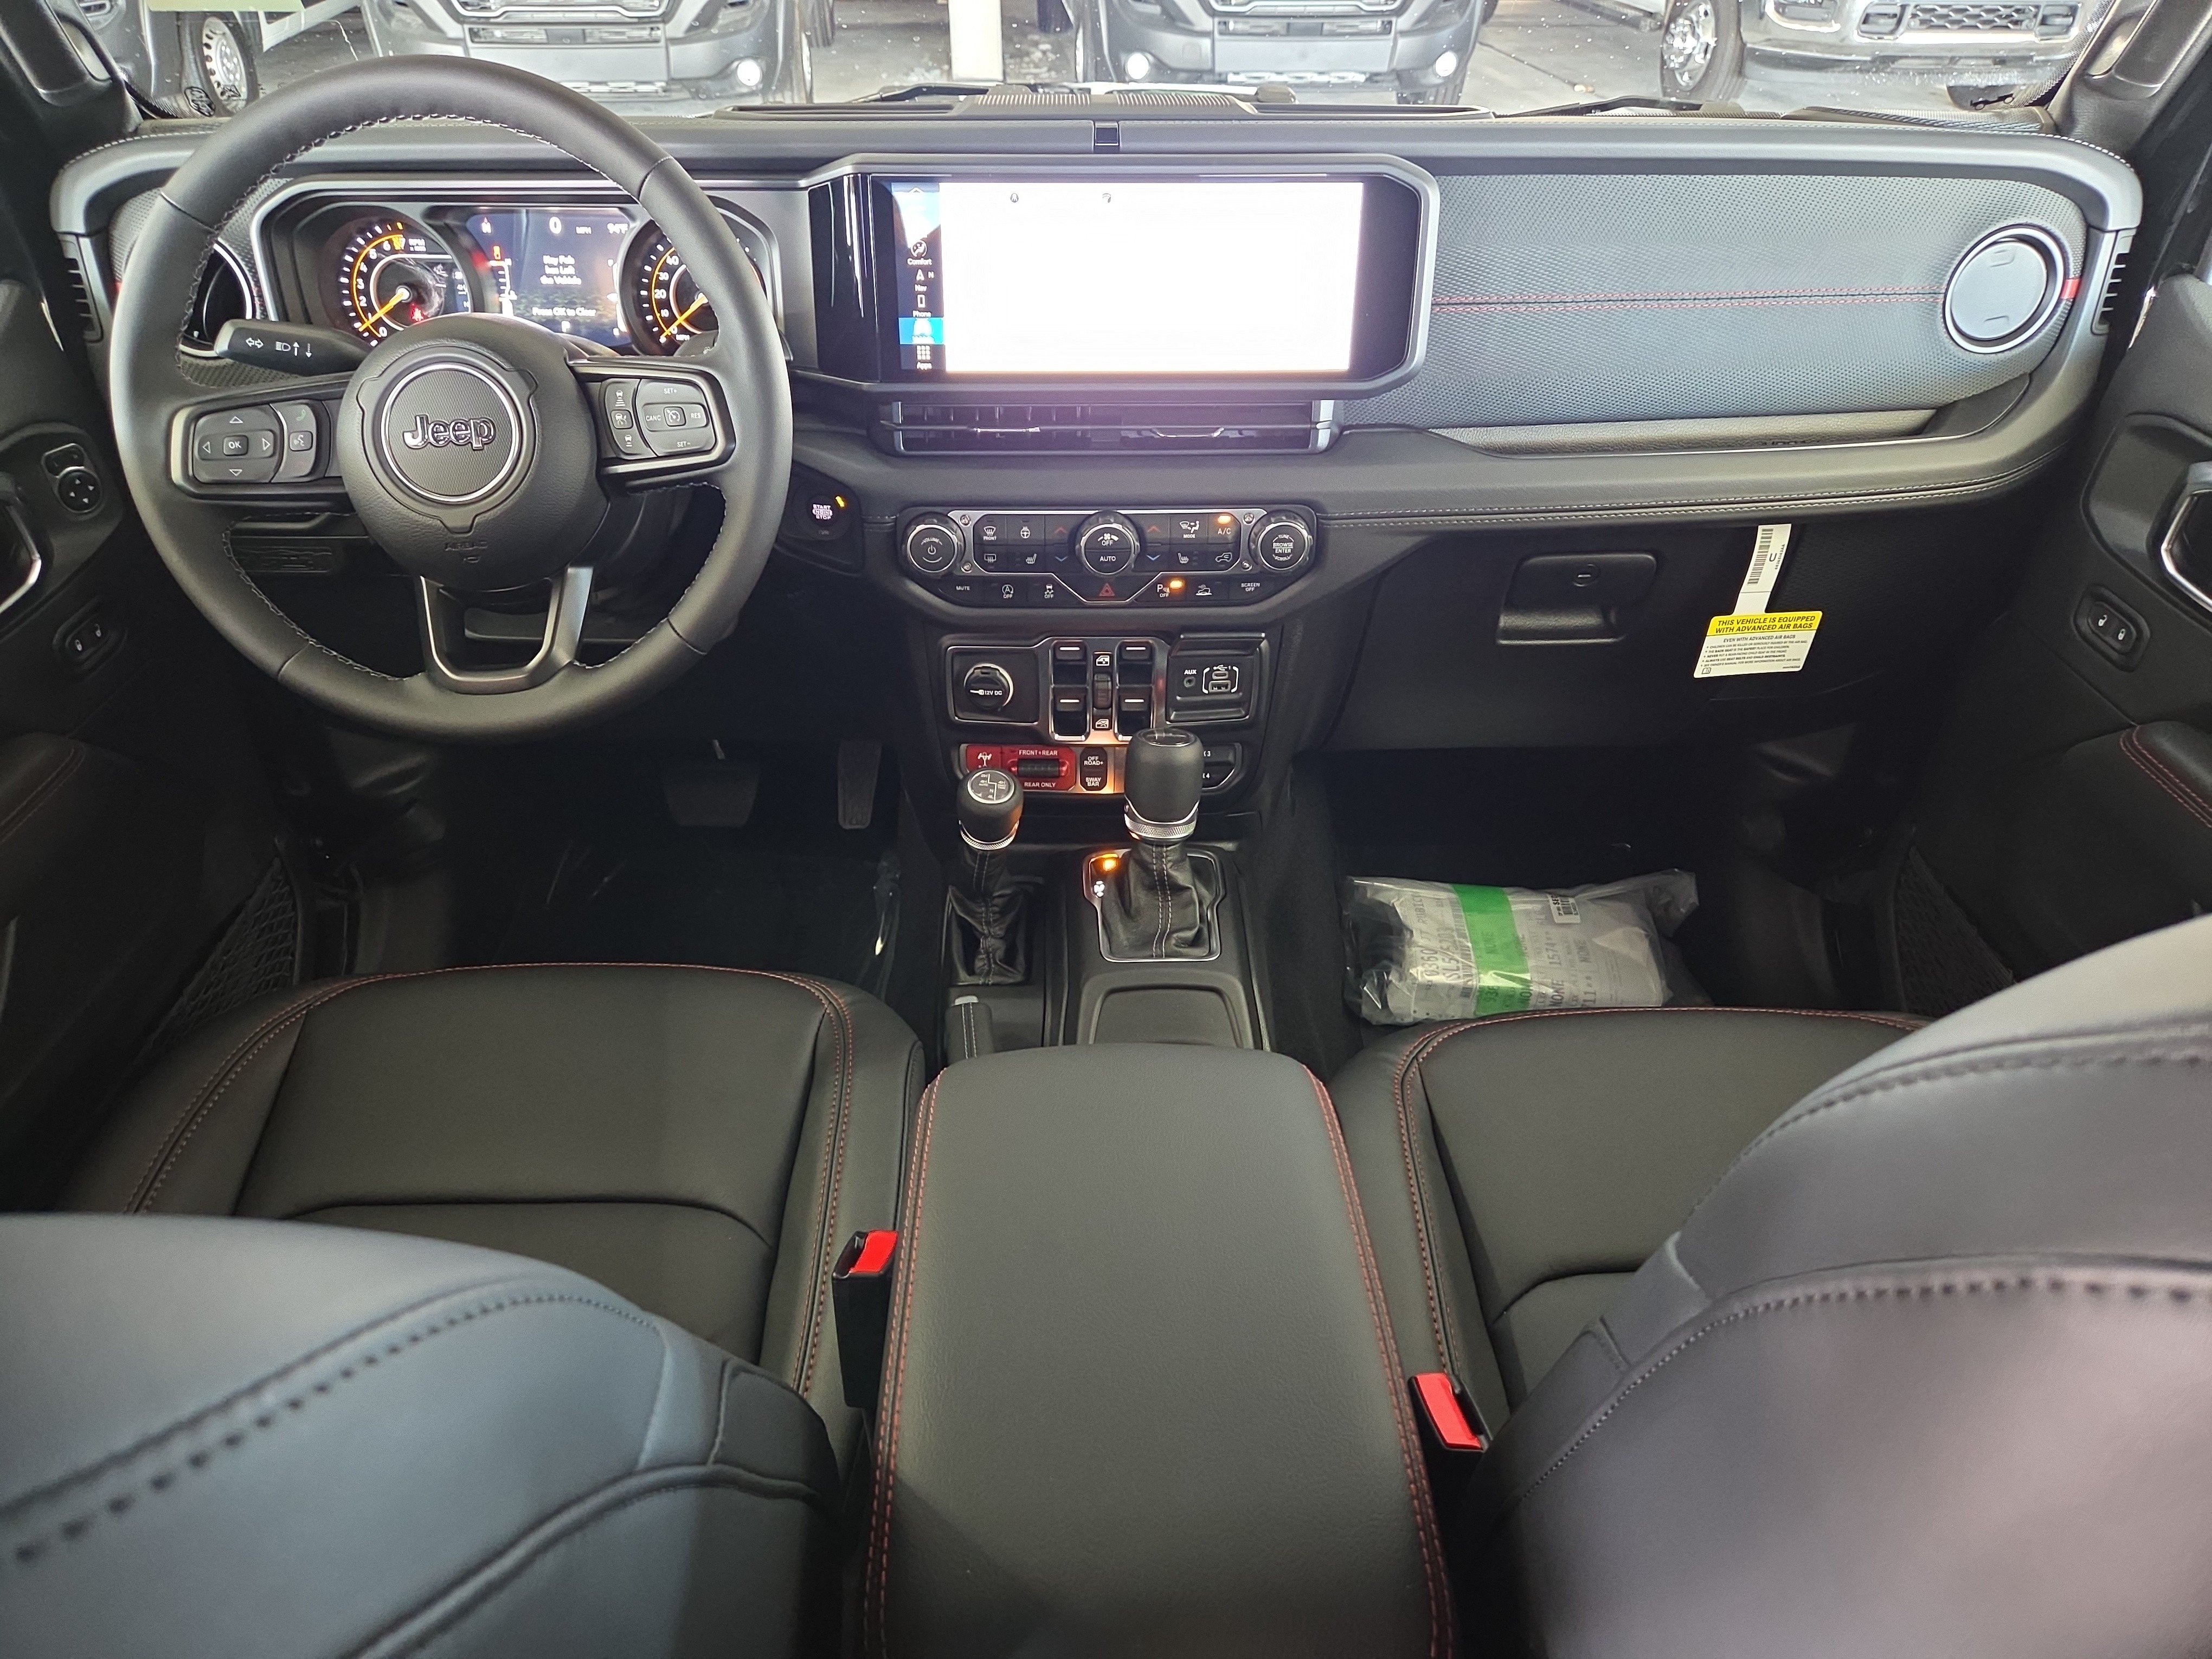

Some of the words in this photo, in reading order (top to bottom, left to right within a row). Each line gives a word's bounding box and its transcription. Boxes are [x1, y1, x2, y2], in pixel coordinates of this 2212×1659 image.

[549, 217, 562, 234] 0
[383, 241, 391, 251] 6
[369, 248, 377, 259] 5
[666, 255, 679, 266] 40
[907, 258, 933, 266] Comfort
[359, 262, 368, 273] 4
[658, 272, 669, 281] 30
[356, 278, 365, 290] 3
[654, 289, 667, 299] 20
[359, 295, 367, 307] 2
[660, 308, 669, 318] 10
[912, 310, 932, 318] Phone
[379, 326, 388, 337] 0
[403, 414, 496, 451] Jeep
[228, 441, 242, 449] OK
[1769, 552, 1777, 562] U
[1735, 624, 1777, 632] ADVANCED
